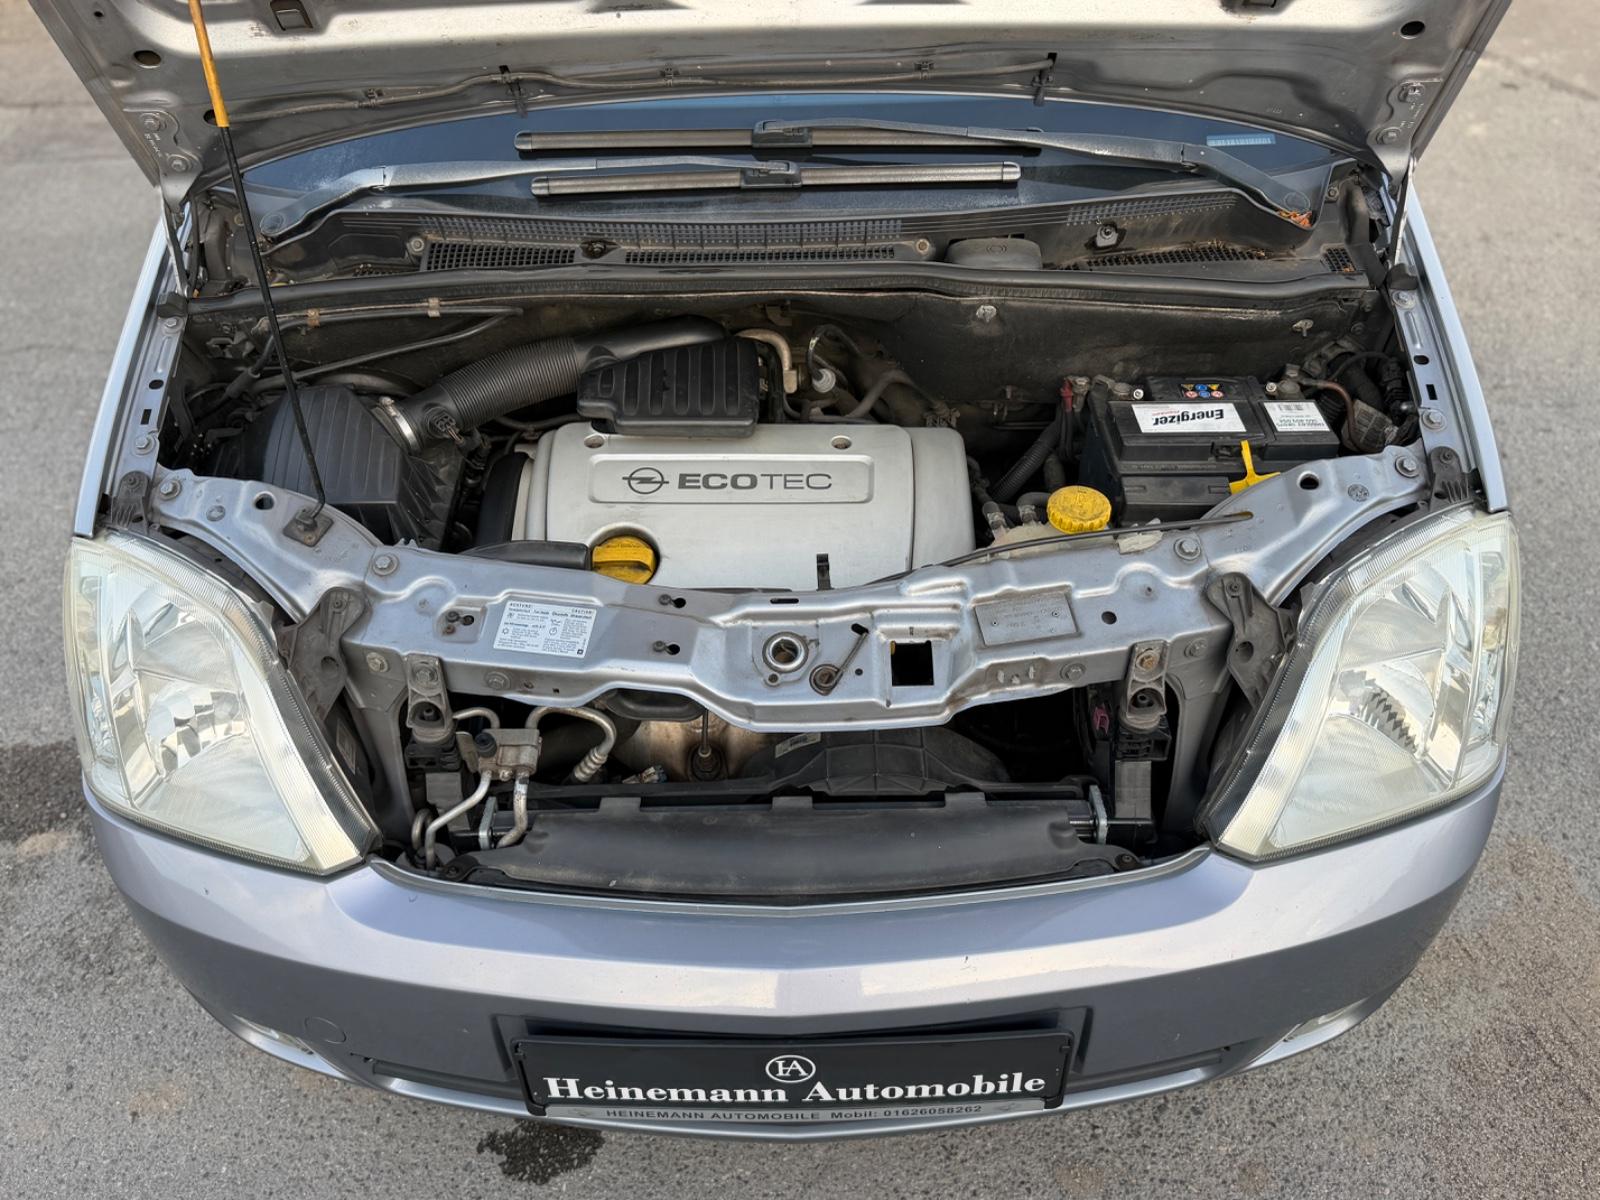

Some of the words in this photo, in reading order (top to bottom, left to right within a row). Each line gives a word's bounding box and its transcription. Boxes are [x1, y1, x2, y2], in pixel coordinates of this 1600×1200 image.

[1152, 409, 1225, 426] Energizer
[677, 473, 833, 491] ECOTEC
[543, 1077, 789, 1103] Heinemann
[801, 1072, 1046, 1102] Automobile
[606, 1109, 704, 1119] HEINEMANN
[711, 1111, 820, 1120] AUTOMOBILE
[831, 1110, 878, 1120] Mobil:
